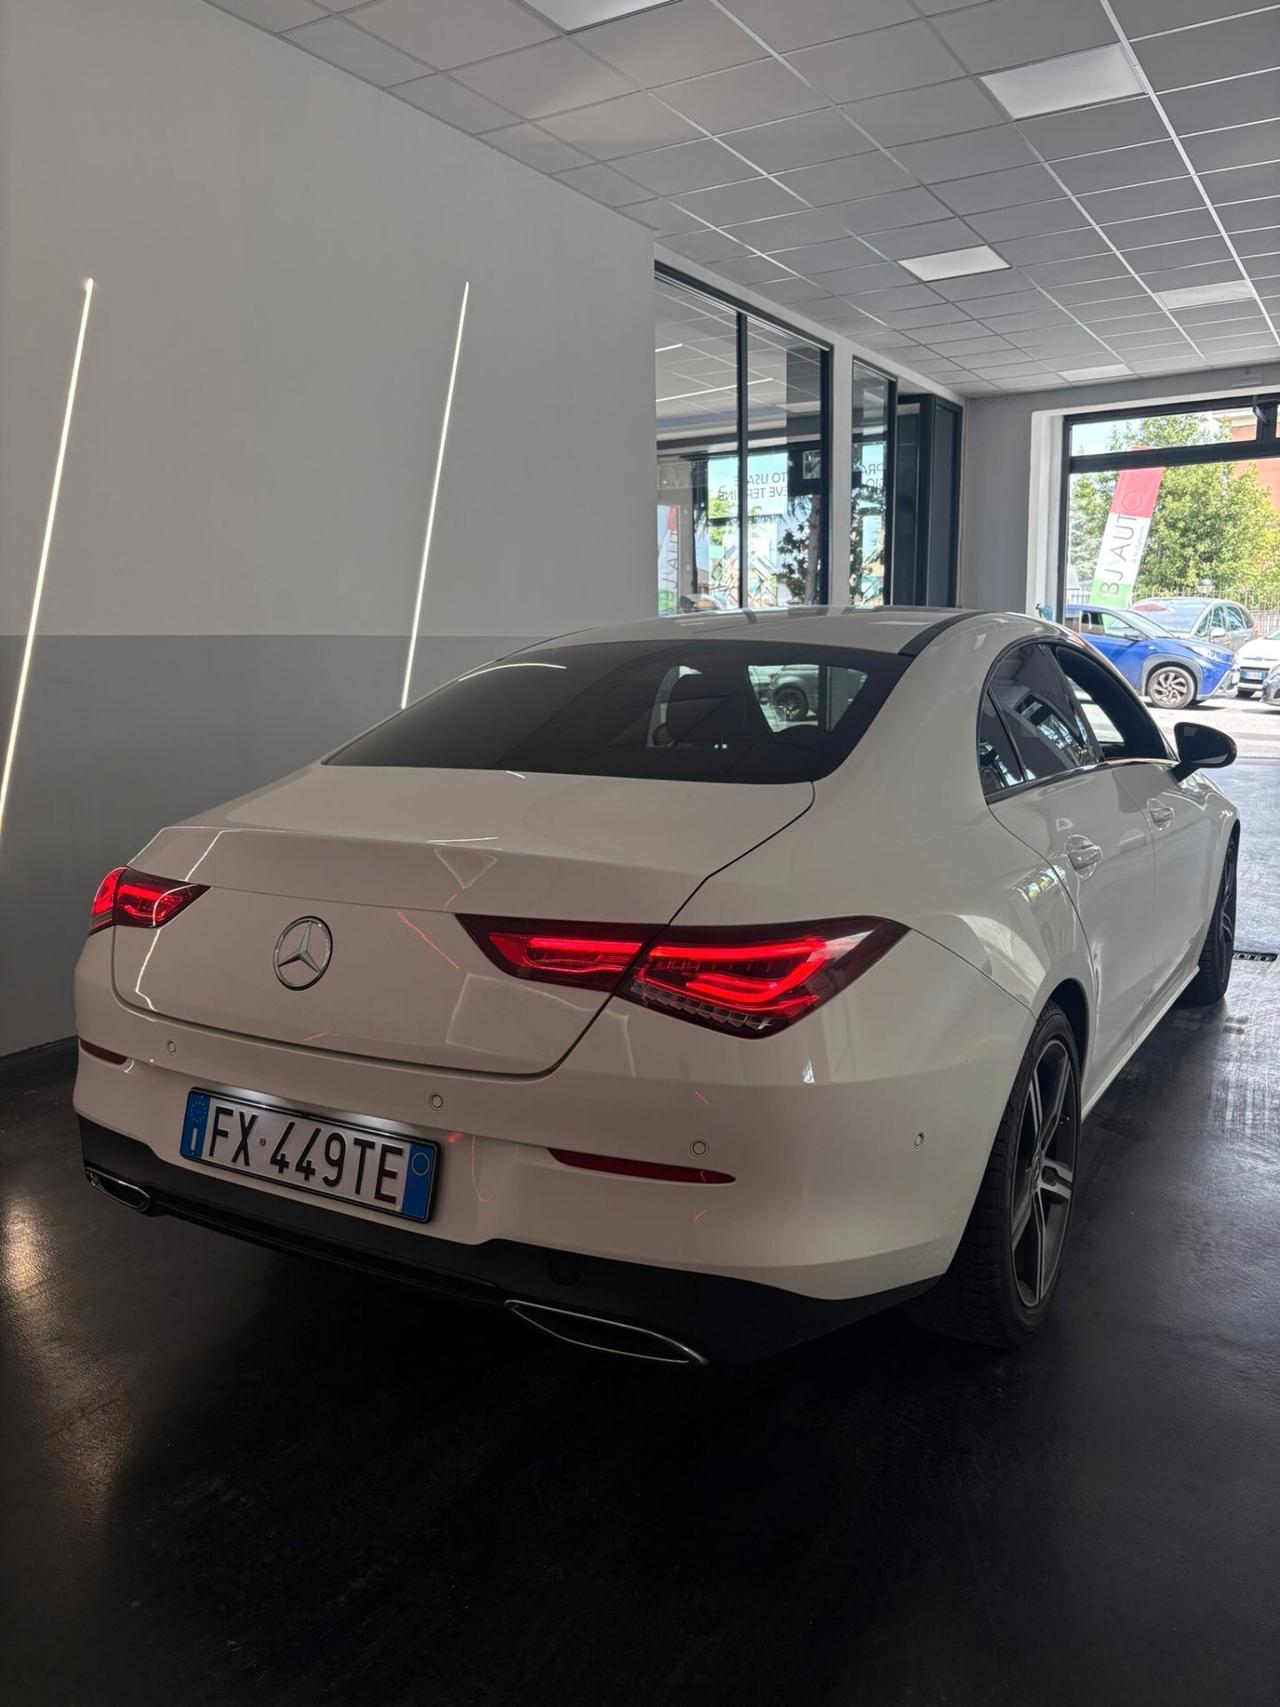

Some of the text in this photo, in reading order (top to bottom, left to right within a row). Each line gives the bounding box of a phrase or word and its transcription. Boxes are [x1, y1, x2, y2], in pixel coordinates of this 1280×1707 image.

[1110, 490, 1143, 561] AUTO
[1100, 568, 1123, 595] BJ
[208, 1105, 258, 1167] FX
